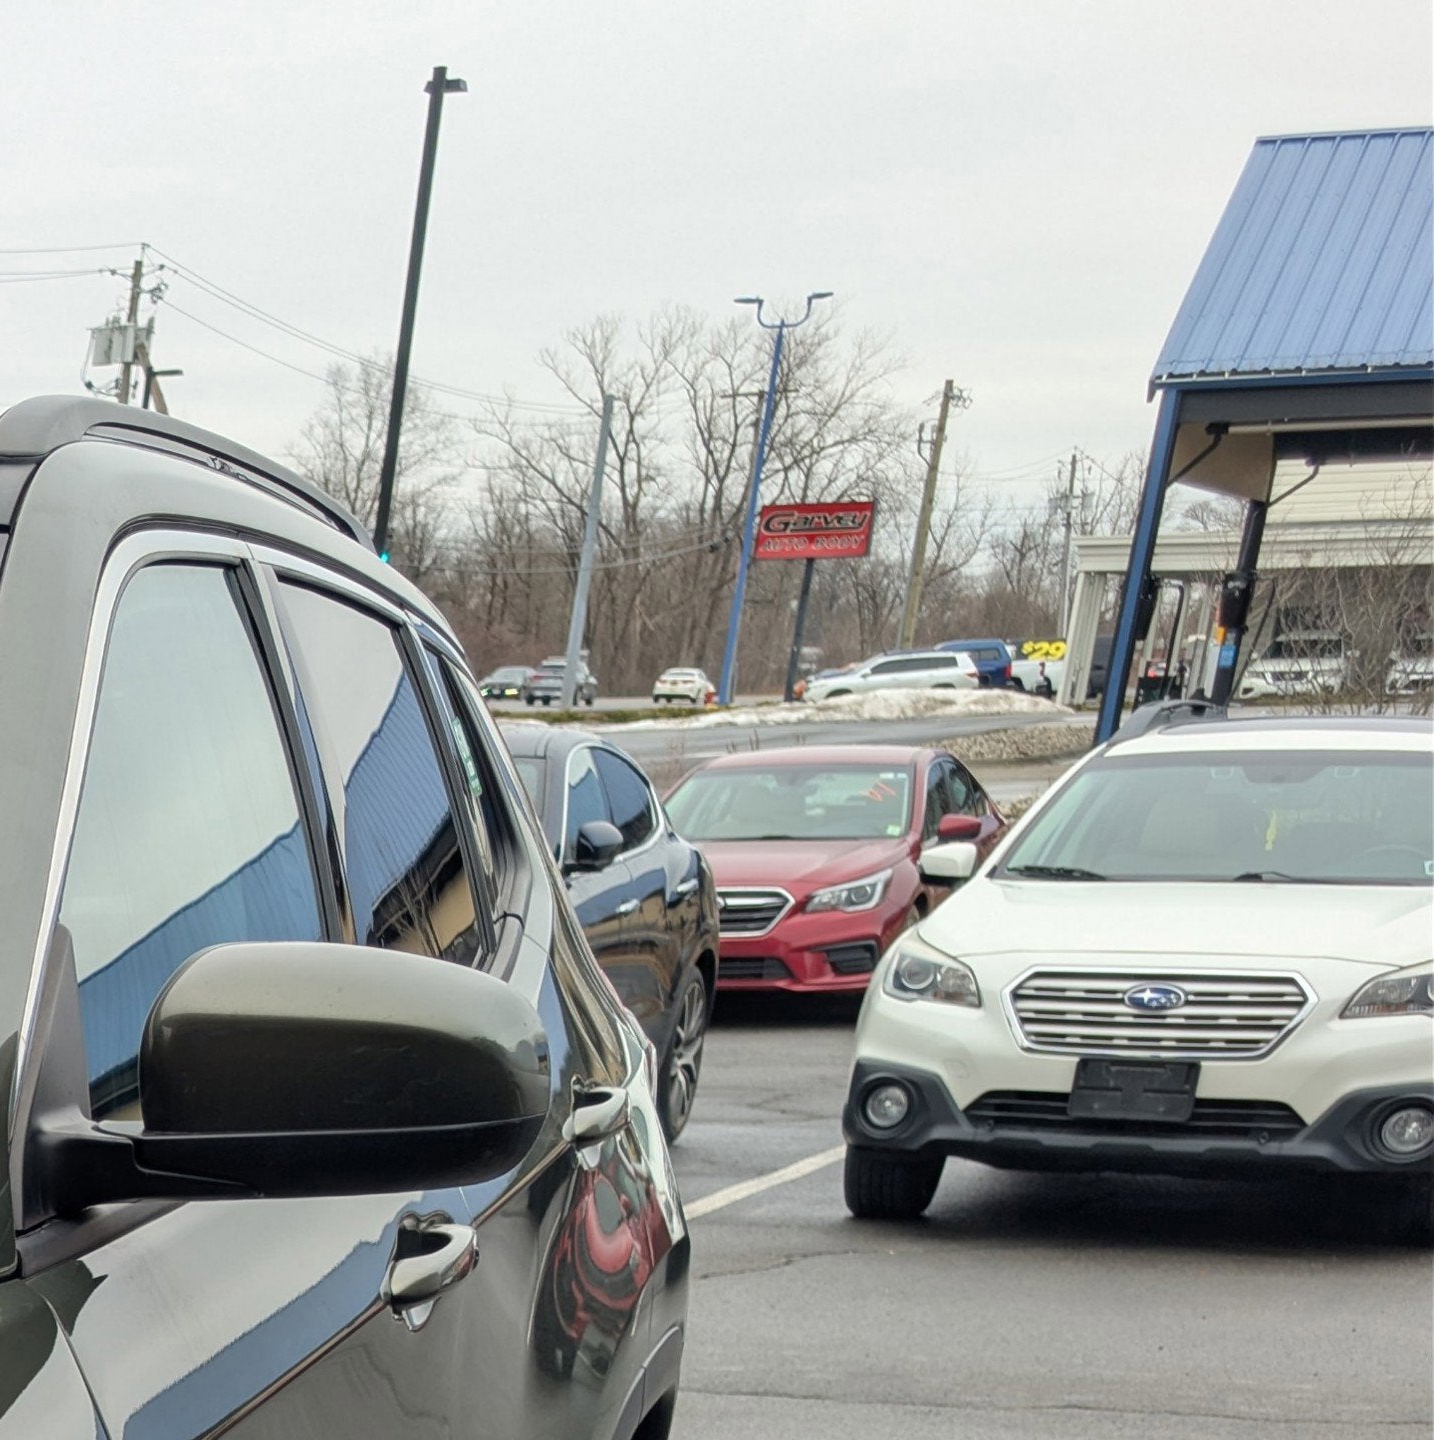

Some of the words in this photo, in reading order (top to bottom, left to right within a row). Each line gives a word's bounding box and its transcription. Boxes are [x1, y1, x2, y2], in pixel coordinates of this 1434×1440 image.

[761, 510, 871, 535] Garvey
[760, 536, 809, 552] AUTO
[812, 534, 866, 550] BODY
